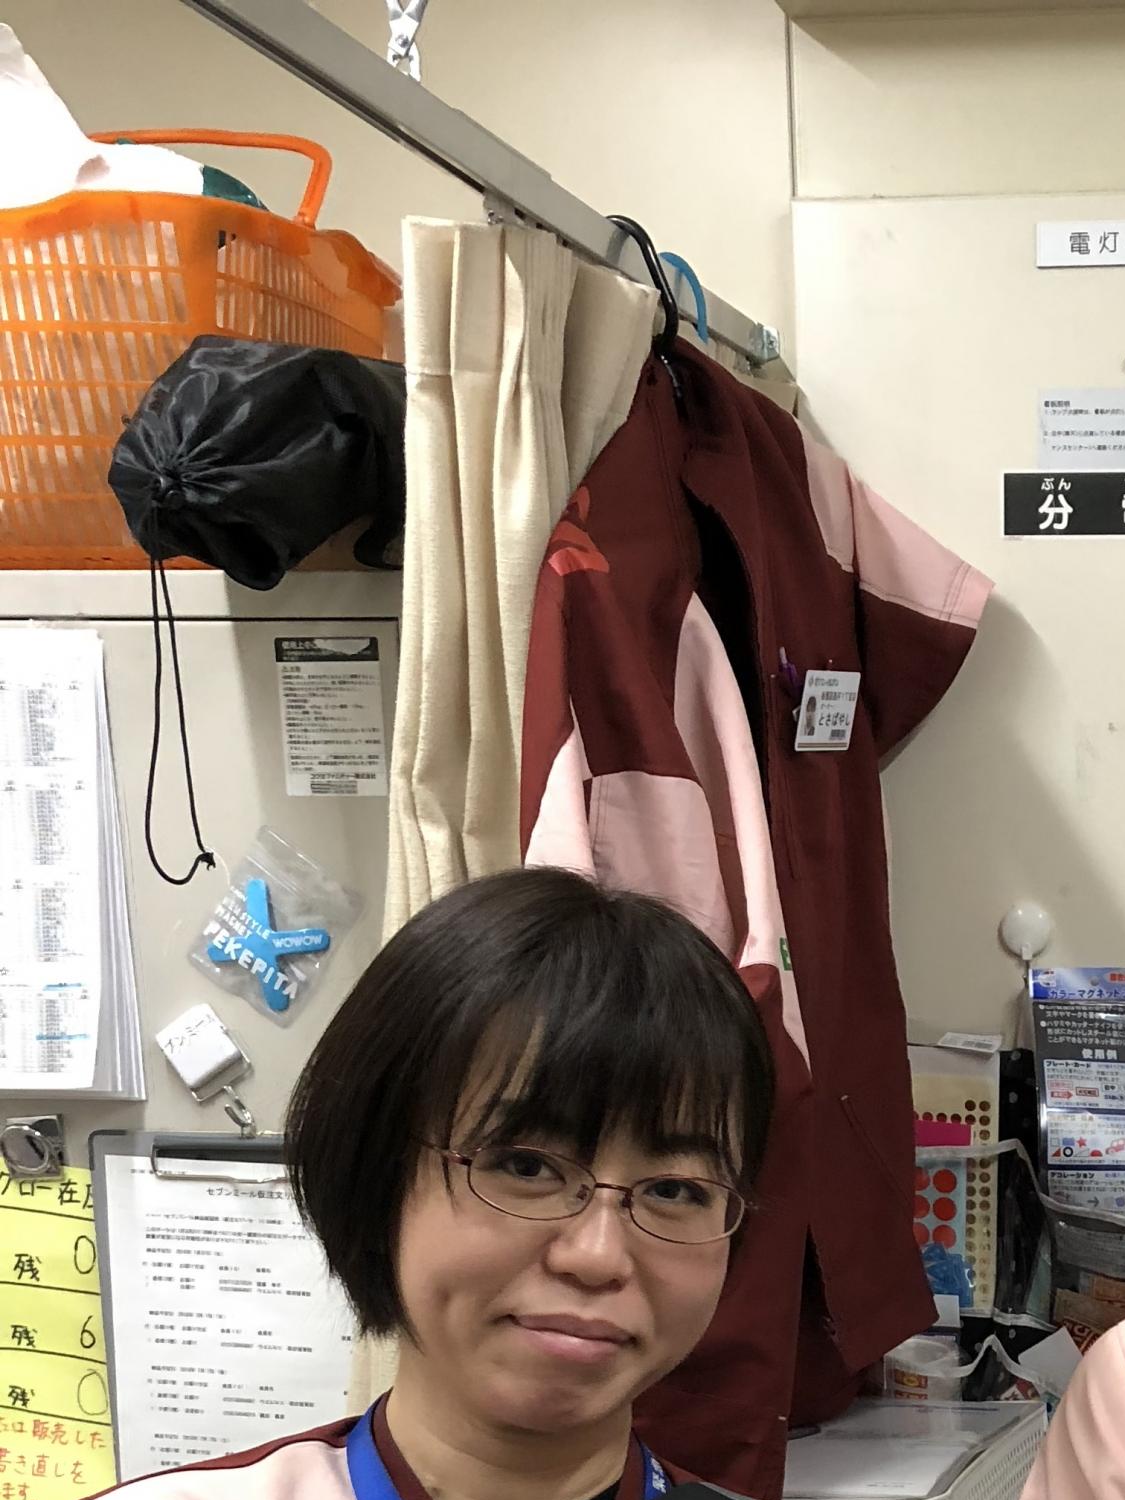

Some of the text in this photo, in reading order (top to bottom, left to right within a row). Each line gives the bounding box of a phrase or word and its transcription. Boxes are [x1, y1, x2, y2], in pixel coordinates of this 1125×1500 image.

[1040, 477, 1072, 491] ぶん
[239, 912, 272, 940] STYLE
[272, 934, 323, 948] WOWOW
[203, 920, 299, 999] PEKEPITA
[79, 1315, 96, 1349] 6
